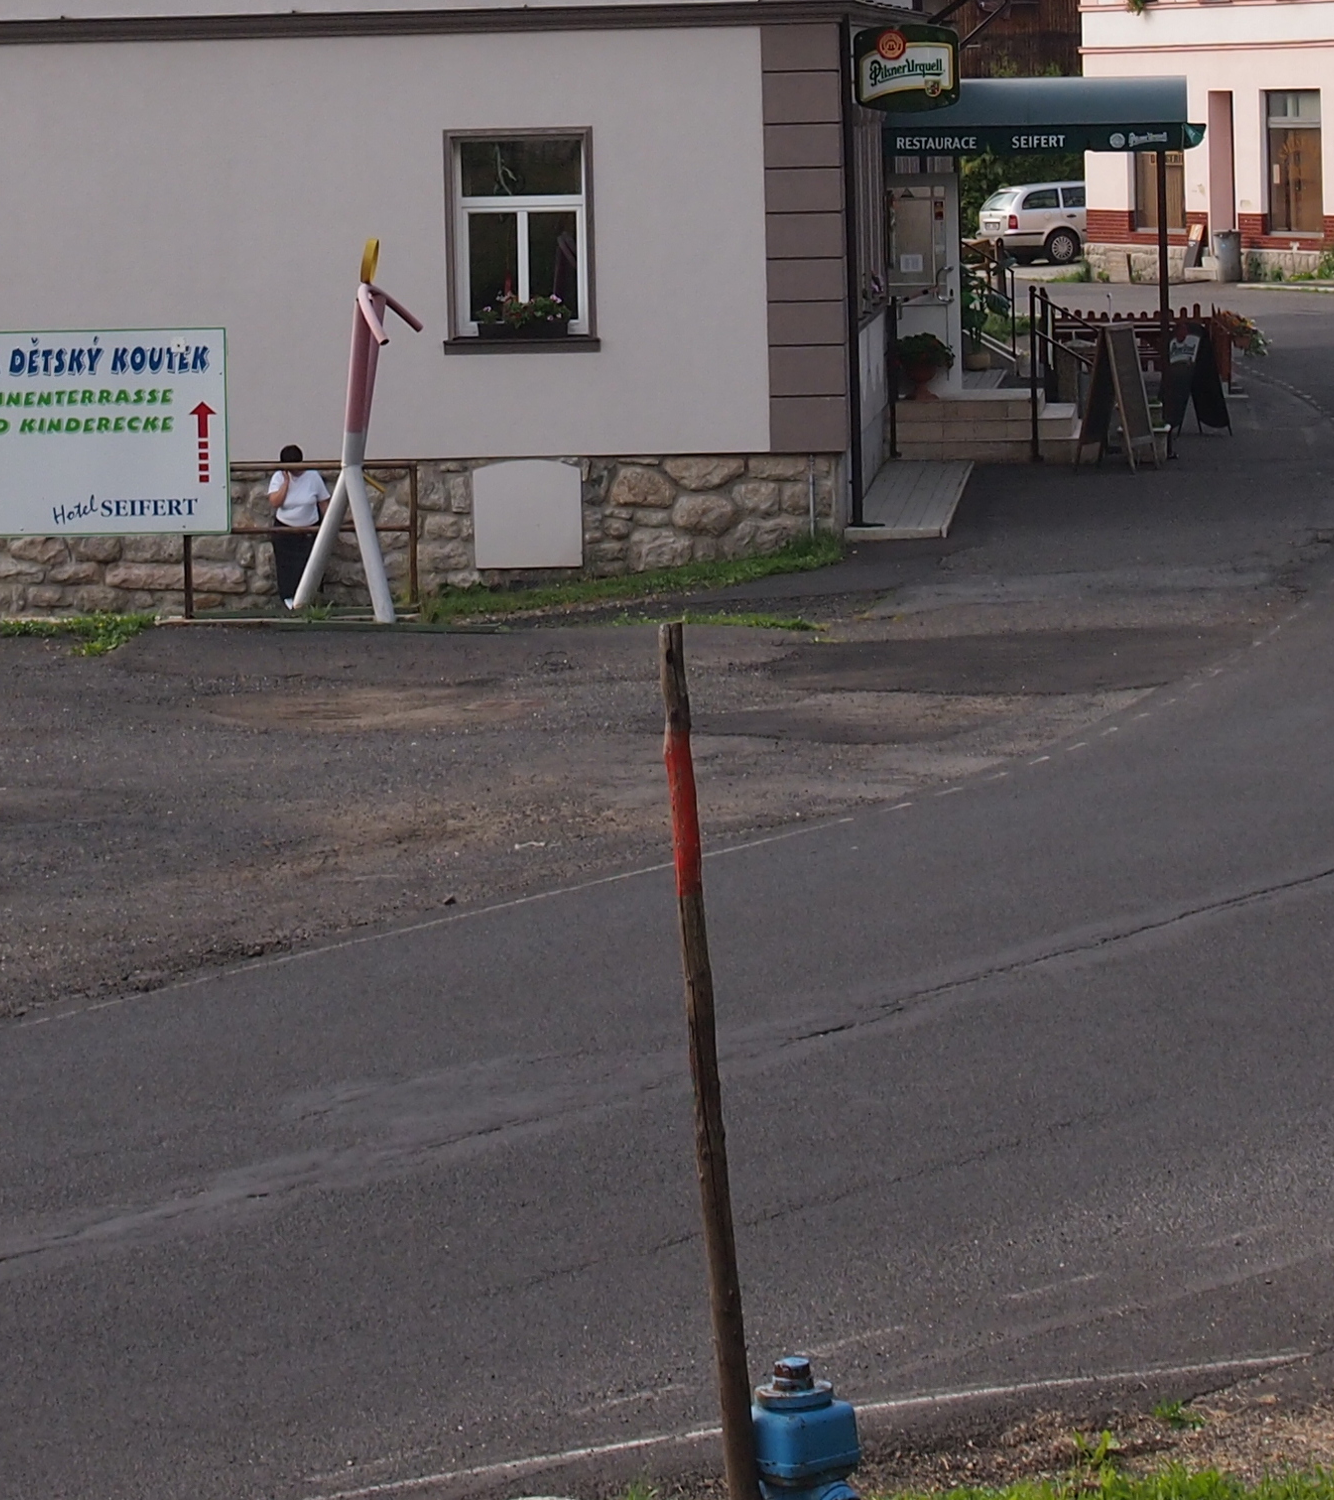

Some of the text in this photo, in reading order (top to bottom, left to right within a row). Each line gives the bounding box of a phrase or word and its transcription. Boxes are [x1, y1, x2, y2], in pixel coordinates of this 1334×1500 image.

[869, 57, 944, 87] Pilsner Urquell
[896, 135, 1065, 150] RESTAURACE SEIFERT
[10, 337, 104, 377] DĚTSKÝ
[111, 343, 211, 375] KOUTEK
[19, 416, 175, 435] KINDERECKE
[53, 494, 199, 526] Hotel SEIFERT
